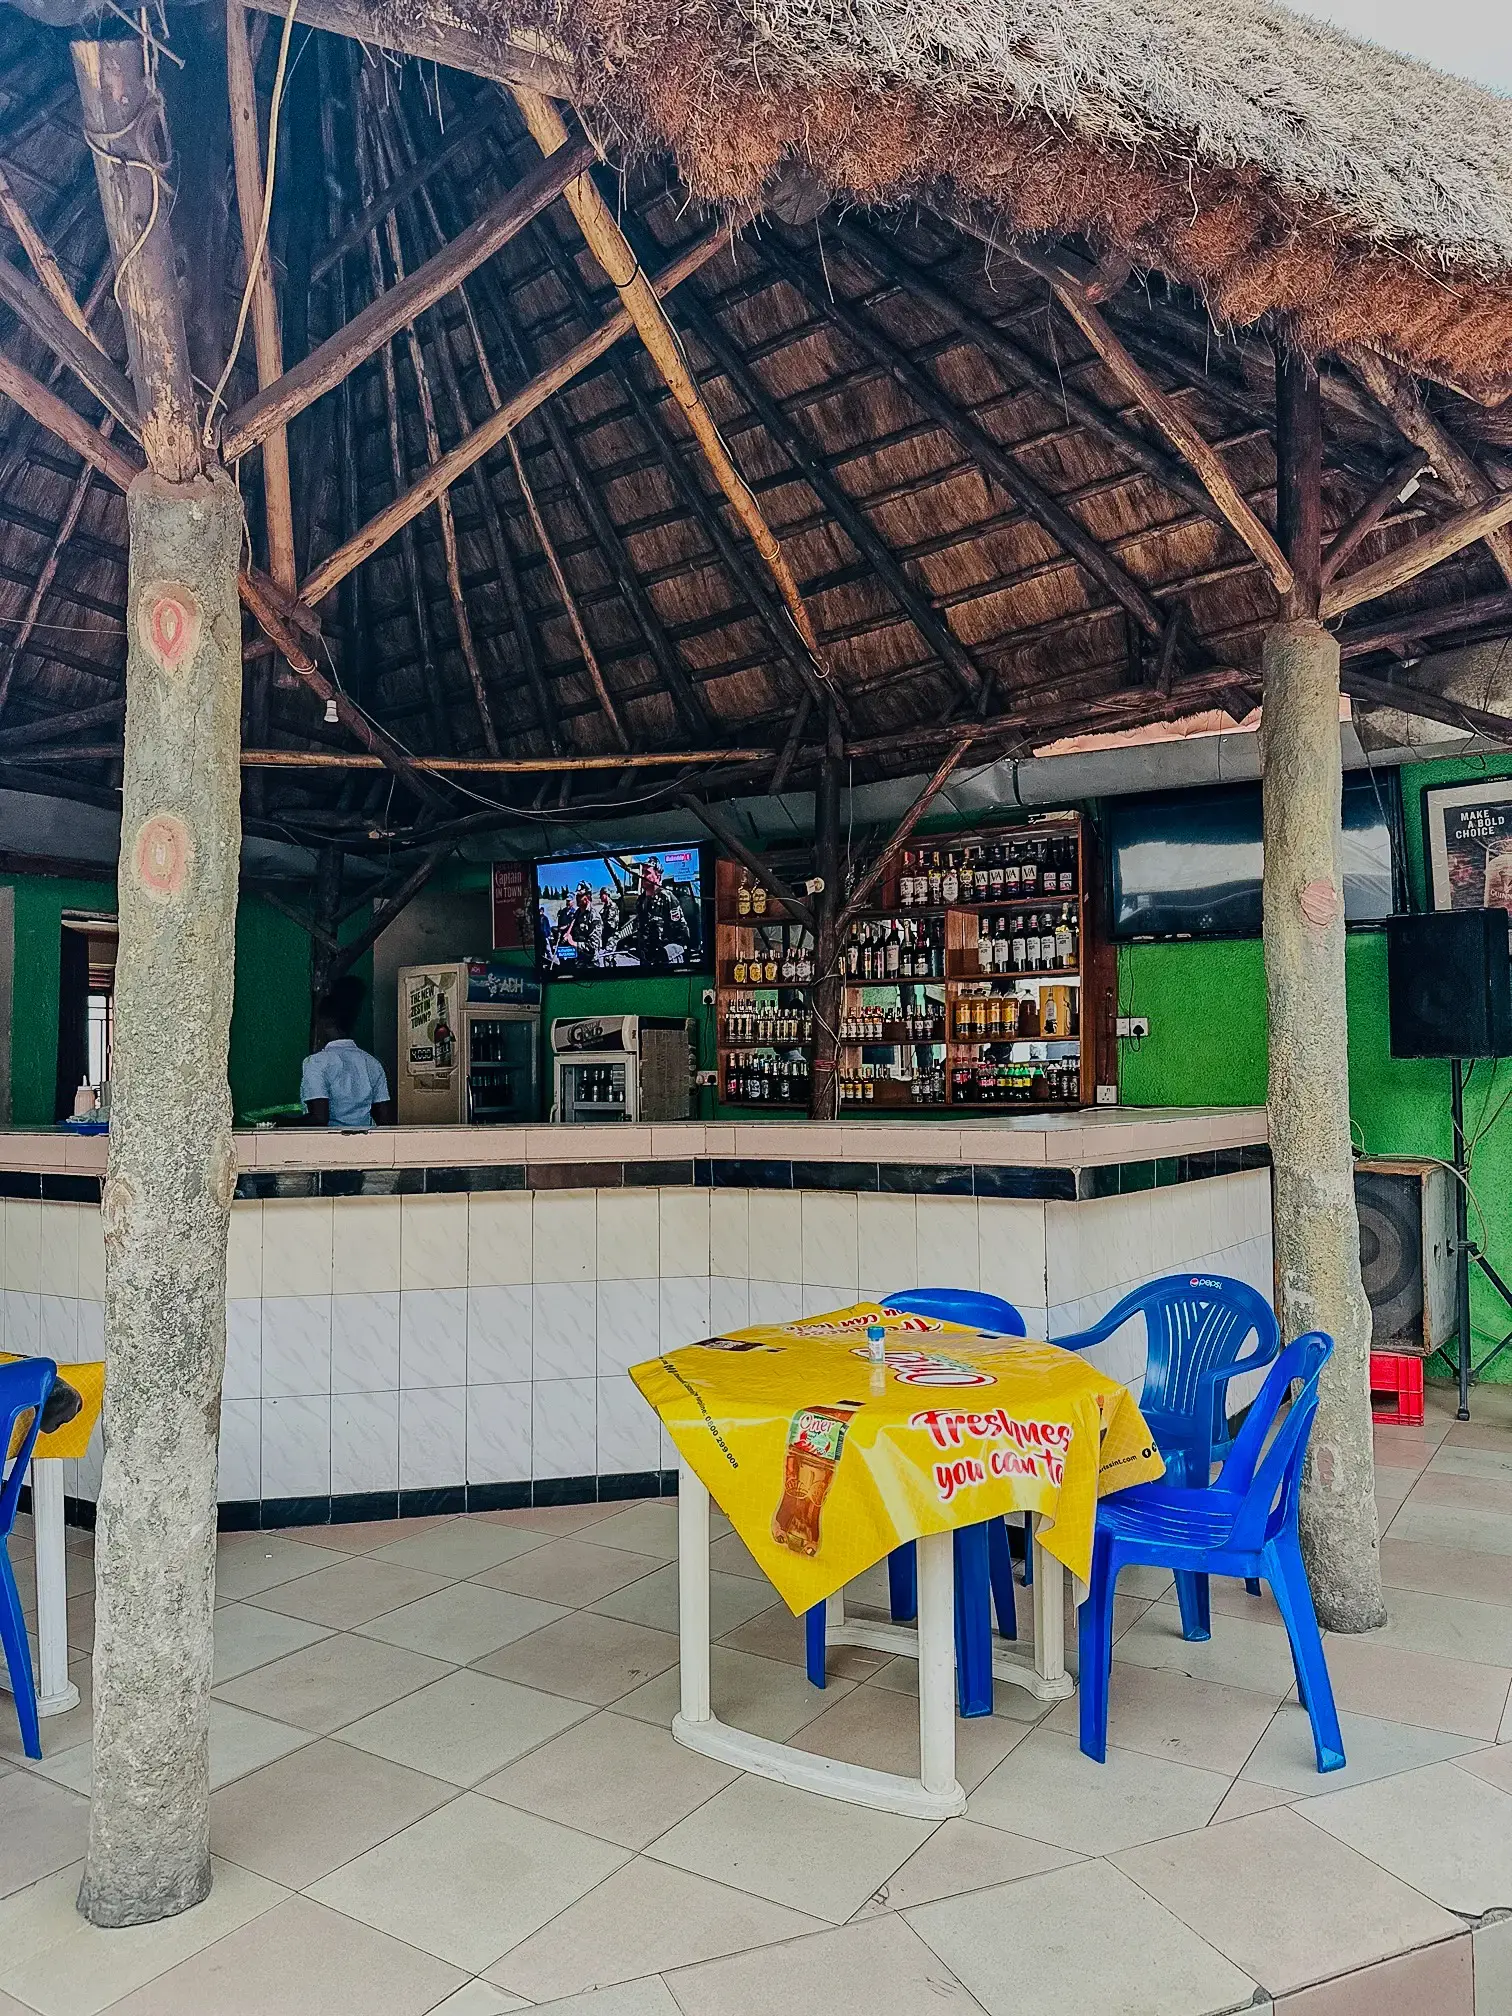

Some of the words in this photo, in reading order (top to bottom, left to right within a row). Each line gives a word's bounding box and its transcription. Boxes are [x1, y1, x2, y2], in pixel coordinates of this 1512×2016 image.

[1460, 809, 1490, 822] MAKE
[1467, 820, 1474, 829] A
[1477, 816, 1505, 828] BOLD
[1455, 826, 1495, 839] CHOICE
[495, 870, 522, 887] Captain
[503, 885, 522, 898] TOWN
[410, 991, 421, 1006] THE
[421, 985, 435, 1001] NEW
[410, 1010, 432, 1029] TOWN?
[1198, 1278, 1223, 1290] pepsi
[705, 1416, 719, 1437] 0800
[715, 1436, 729, 1453] 299
[726, 1452, 739, 1469] 008
[936, 1460, 985, 1500] you
[991, 1452, 1038, 1478] can
